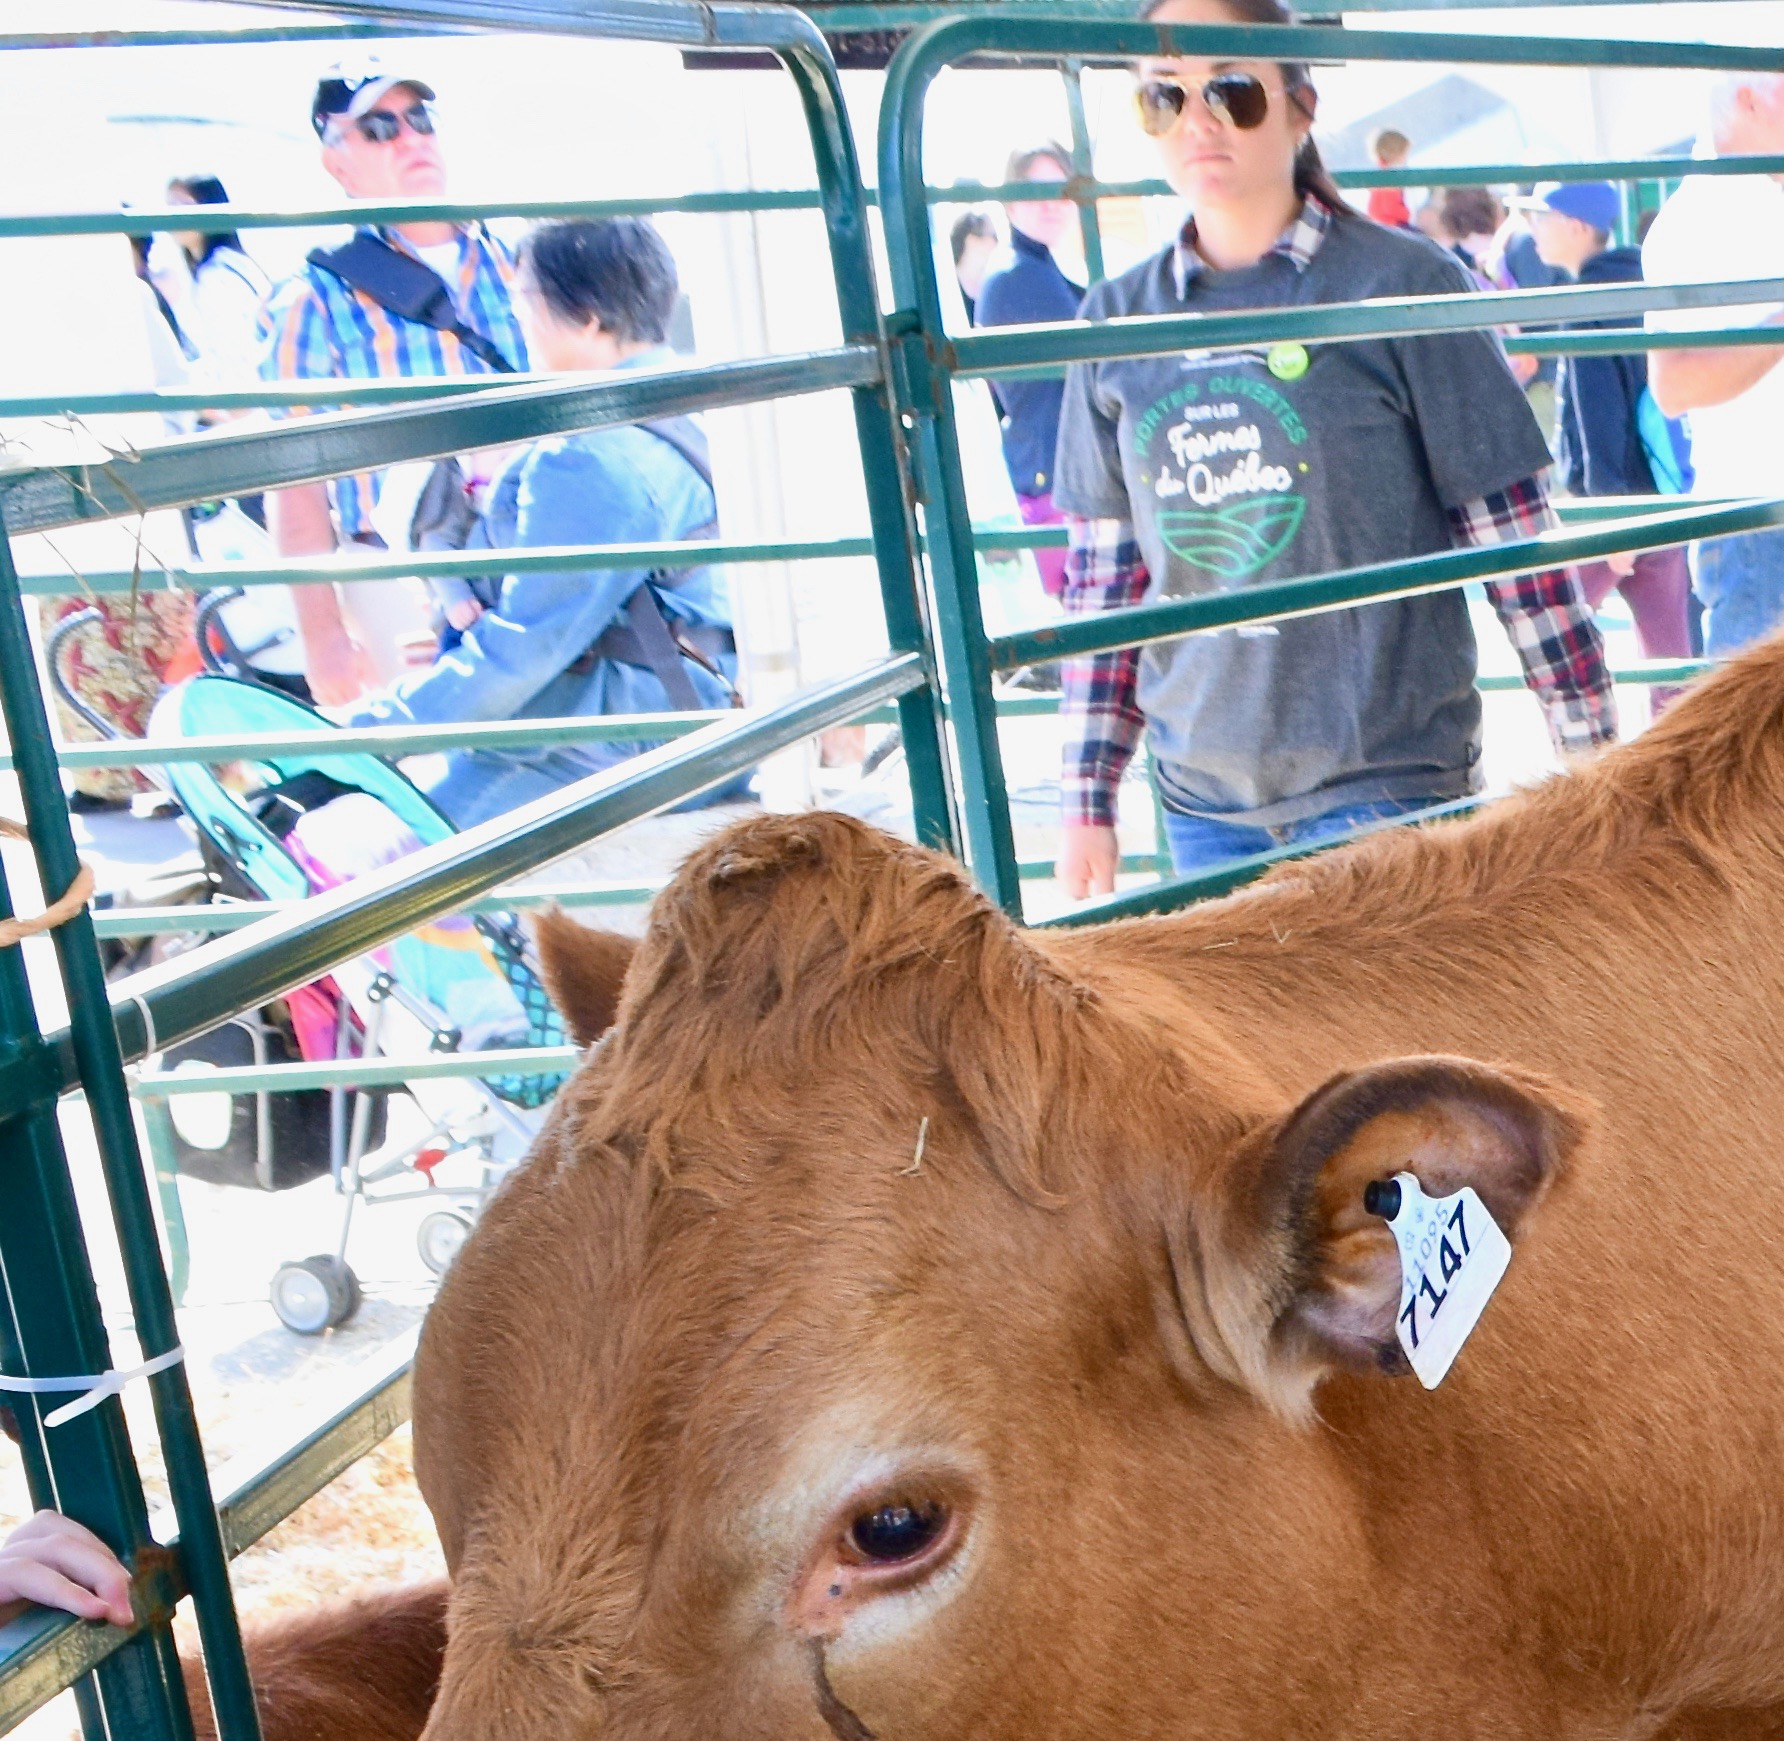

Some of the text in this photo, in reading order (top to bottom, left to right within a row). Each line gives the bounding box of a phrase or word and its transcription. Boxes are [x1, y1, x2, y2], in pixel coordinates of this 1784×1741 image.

[1208, 375, 1308, 445] OUVERTES
[1167, 421, 1262, 468] Fermes
[1155, 450, 1292, 506] du Québec
[1400, 1199, 1470, 1349] 7147
